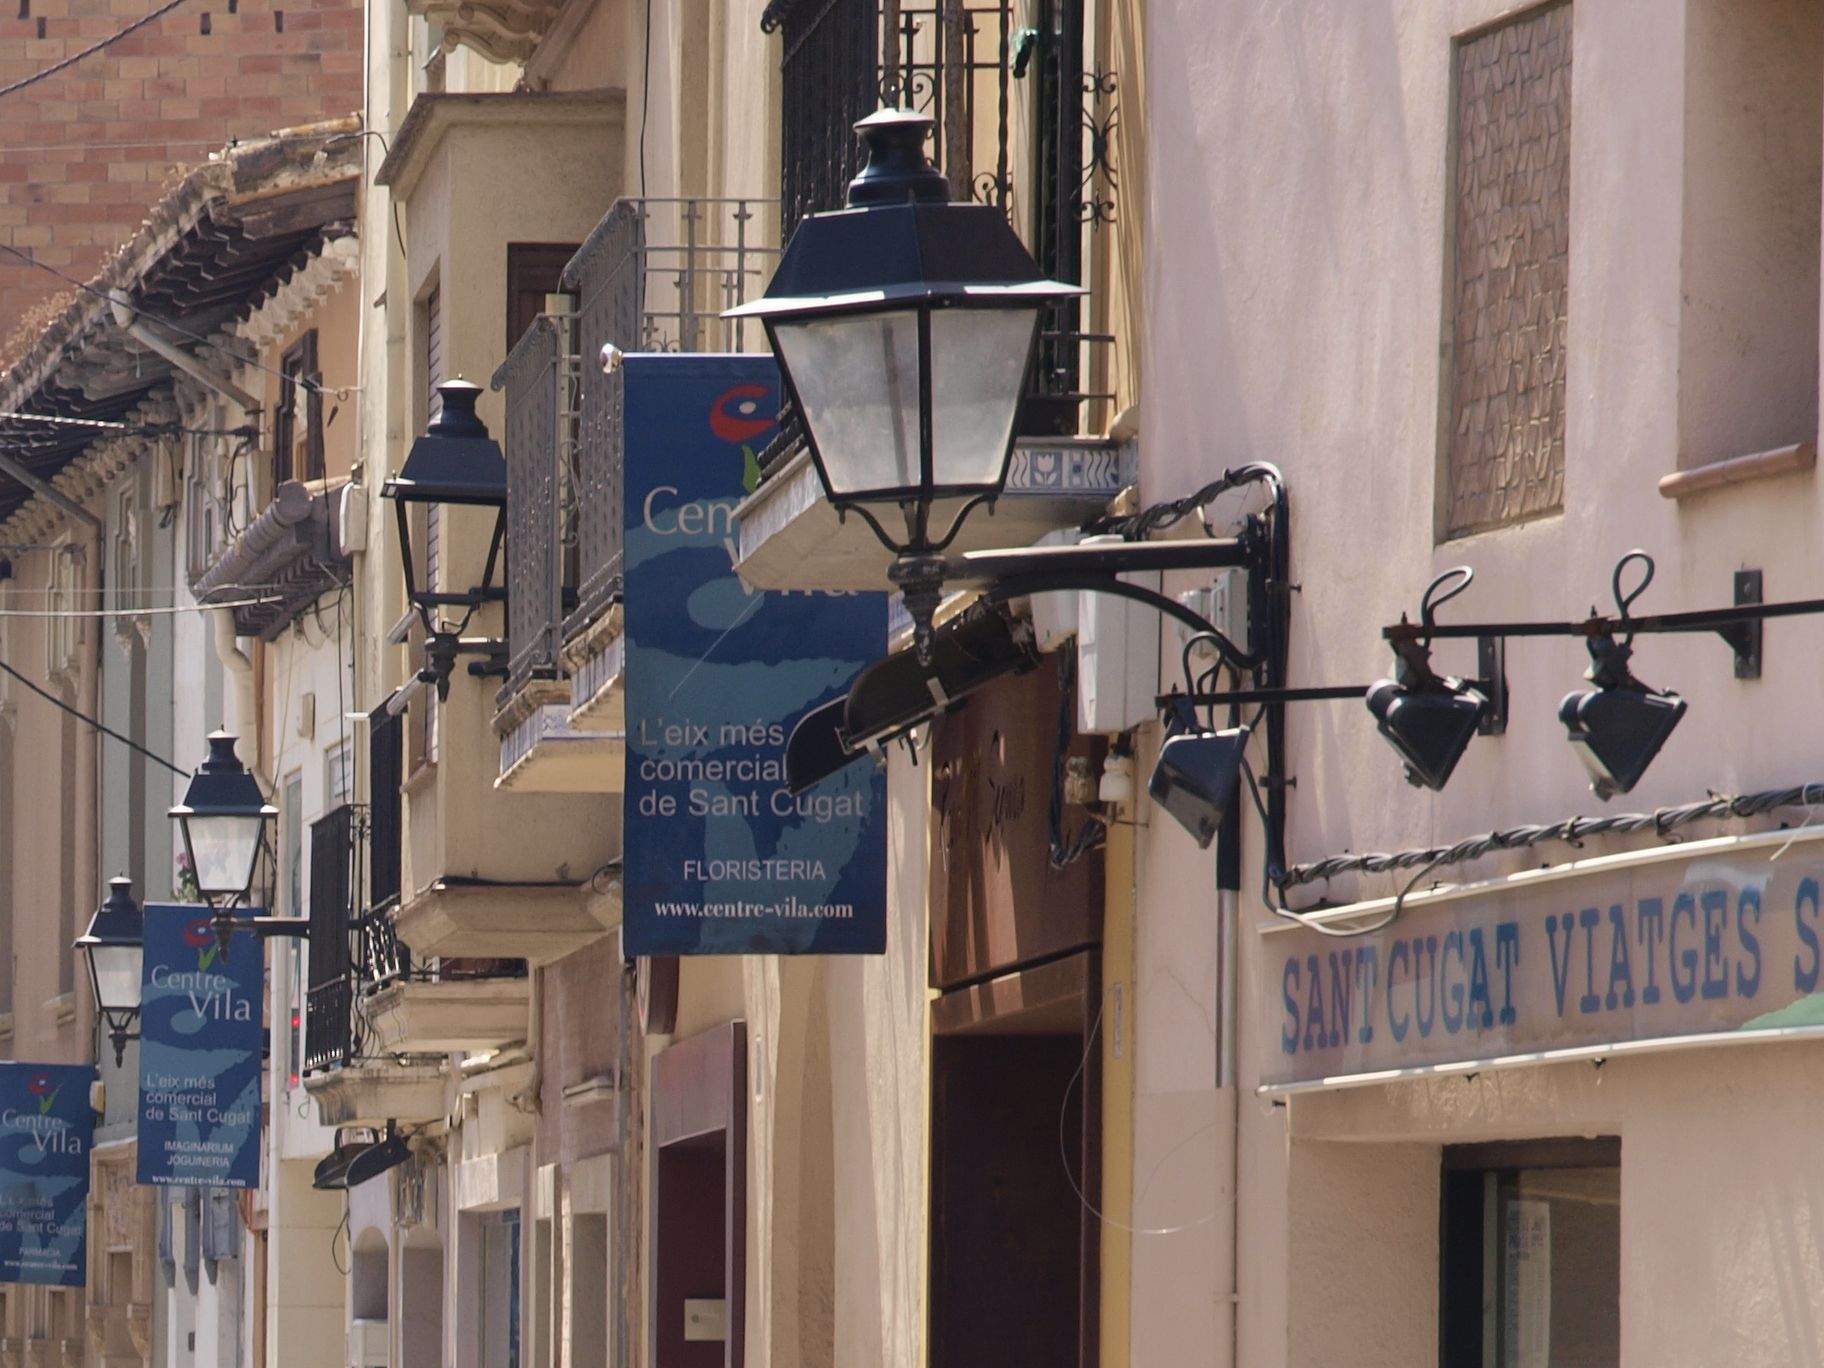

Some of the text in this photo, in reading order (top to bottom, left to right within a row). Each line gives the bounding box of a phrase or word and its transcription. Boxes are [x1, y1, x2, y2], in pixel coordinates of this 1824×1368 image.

[640, 718, 784, 746] L'eix més
[639, 753, 787, 782] comercial
[638, 788, 864, 823] de Sant Cugat
[683, 859, 827, 881] FLORISTERIA
[654, 896, 854, 919] www.centre-vila.com
[151, 964, 227, 991] Centre
[1280, 944, 1377, 1056] SANT
[1386, 920, 1521, 1043] CUGAT
[1544, 882, 1763, 1018] VIATGES
[188, 988, 251, 1022] Vila
[147, 1073, 216, 1090] L'eix més
[146, 1090, 217, 1106] comercial
[2, 1108, 64, 1130] Centre
[145, 1107, 251, 1127] de Sant Cugat
[32, 1128, 82, 1155] Vila
[164, 1140, 234, 1154] IMAGINARIUM
[167, 1155, 230, 1168] JOGUINERIA
[152, 1173, 246, 1188] www.centre-vila.com
